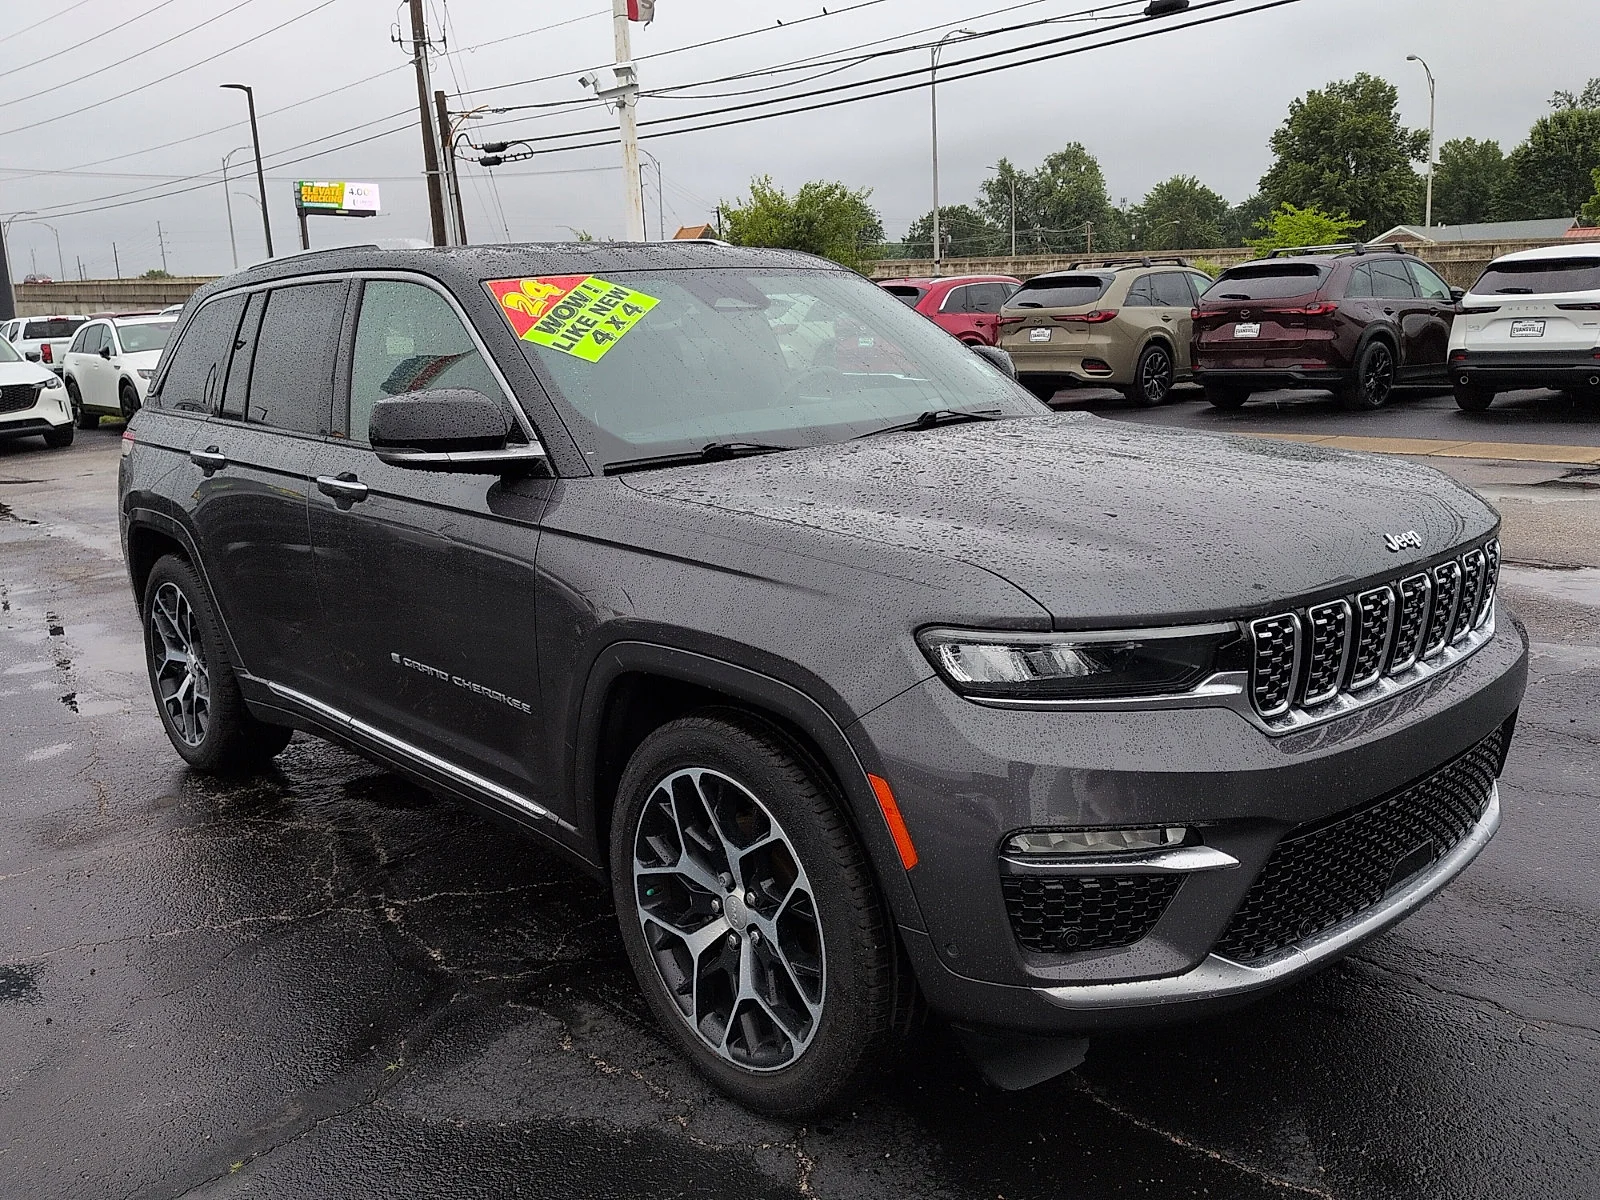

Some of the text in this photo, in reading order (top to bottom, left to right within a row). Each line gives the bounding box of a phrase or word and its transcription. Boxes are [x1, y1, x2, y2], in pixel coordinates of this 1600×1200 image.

[301, 186, 342, 196] ELEVATE
[301, 194, 343, 203] CHECKING
[503, 279, 566, 317] 24
[552, 287, 630, 351] LIKE NEW
[1384, 530, 1421, 551] Jeep
[402, 657, 532, 714] GRAND CHEROKEE
